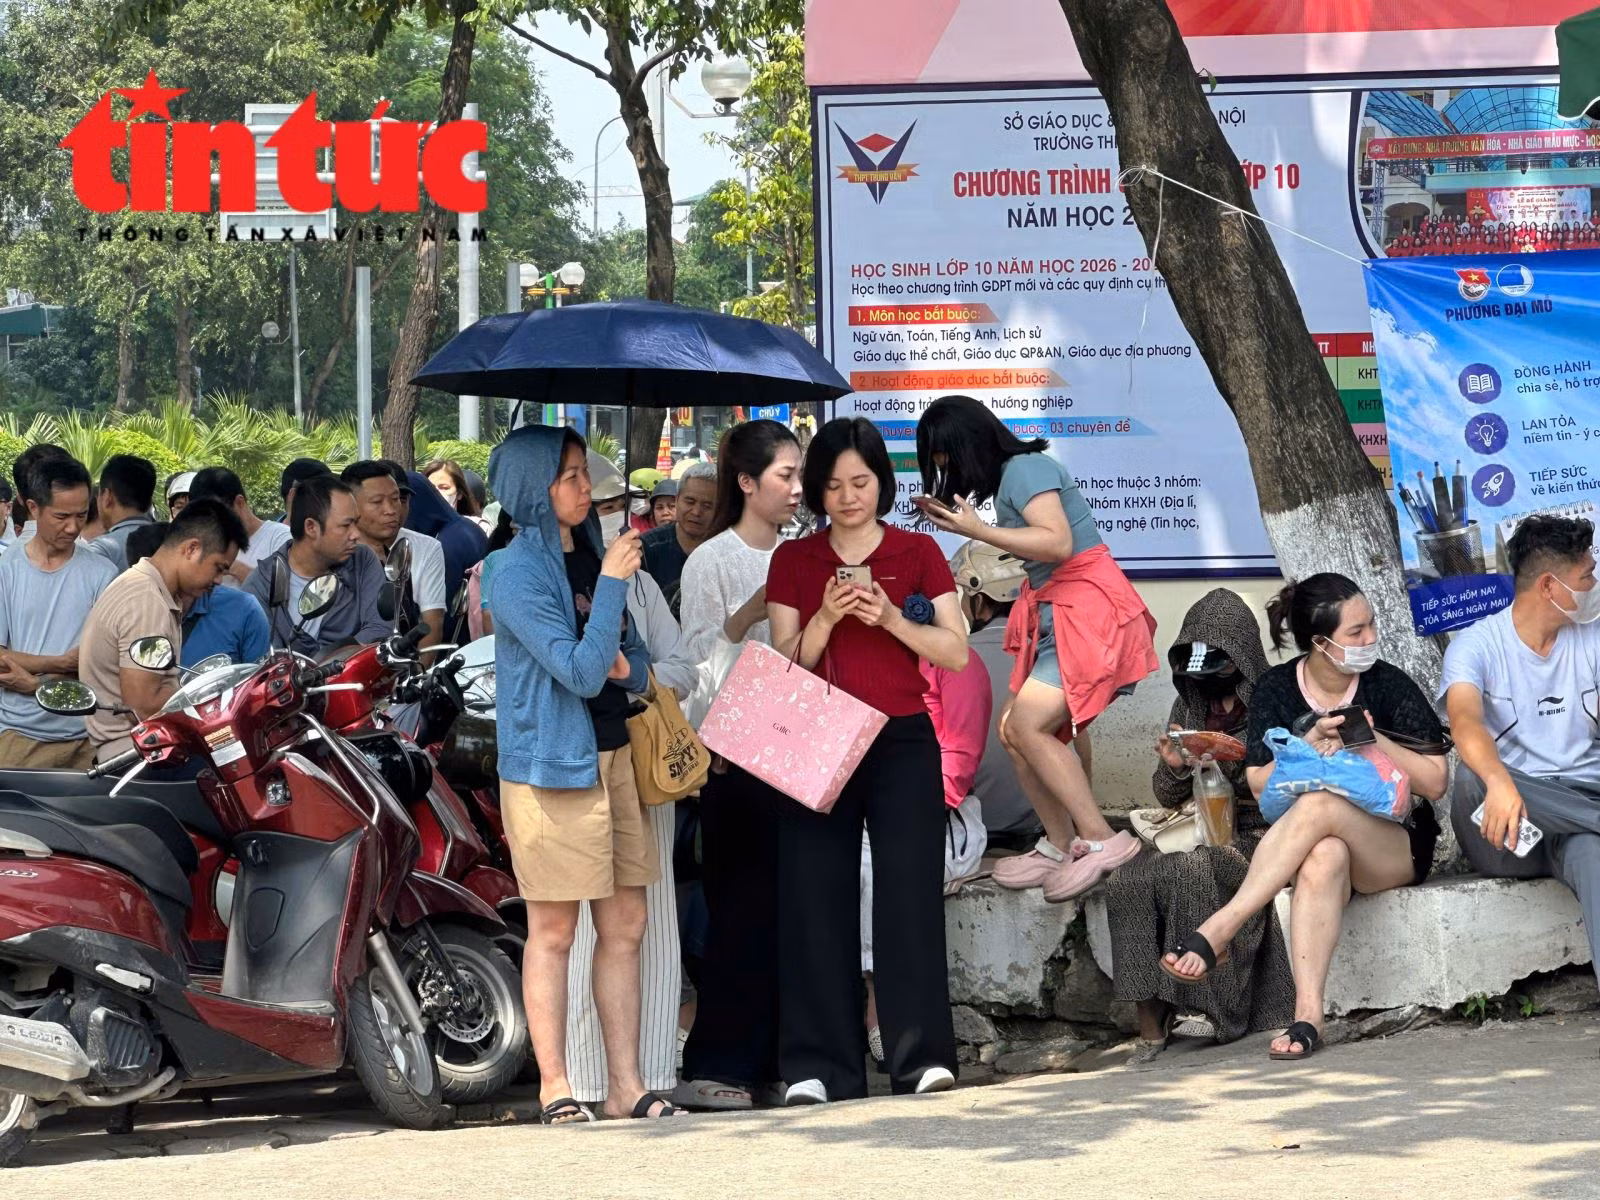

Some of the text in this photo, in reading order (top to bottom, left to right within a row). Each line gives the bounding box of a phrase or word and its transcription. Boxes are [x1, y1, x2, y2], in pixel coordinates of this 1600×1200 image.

[1004, 111, 1024, 130] SỞ
[1028, 112, 1067, 129] GIÁO
[1072, 114, 1103, 131] DỤC
[1218, 106, 1246, 127] NỘI
[1034, 132, 1093, 151] TRƯỜNG
[1486, 136, 1501, 150] HÓA
[1508, 135, 1523, 149] NHÀ
[1525, 134, 1542, 149] GIÁO
[1562, 133, 1580, 150] MỰC
[854, 174, 868, 182] THPT
[953, 168, 1041, 198] CHƯƠNG
[1047, 163, 1110, 195] TRÌNH
[1240, 159, 1266, 190] ỚP
[1275, 163, 1300, 190] 10
[1007, 202, 1057, 228] NĂM
[1066, 205, 1114, 230] HỌC
[851, 264, 886, 280] HỌC
[892, 263, 930, 277] SINH
[936, 259, 968, 276] LỚP
[975, 261, 992, 275] 10
[998, 257, 1034, 274] NĂM
[1039, 259, 1074, 276] HỌC
[1080, 258, 1117, 272] 2026
[851, 276, 1166, 297] Học theo chương trình GDPT mới và các quy định cụ th
[856, 305, 981, 323] 1. Môn học bắt buộc:
[1446, 302, 1501, 322] PHƯỜNG
[1504, 302, 1527, 318] ĐẠI
[853, 325, 1042, 345] Ngữ văn, Toán, Tiếng Anh, Lịch sử
[853, 343, 1191, 364] Giáo dục thể chất, Giáo dục QP&AN, Giáo dục địa phương
[1362, 341, 1376, 354] NH
[1358, 368, 1379, 379] KHT
[1514, 360, 1591, 379] ĐỒNG HÀNH
[873, 375, 899, 388] Hoạt
[903, 373, 933, 388] động
[937, 373, 964, 389] giáo
[967, 373, 989, 387] dục
[993, 369, 1012, 385] bắt
[1016, 371, 1050, 385] buộc:
[1517, 375, 1600, 394] chia sẻ, hỗ trợ
[854, 400, 881, 414] Hoạt
[884, 399, 915, 414] động
[991, 396, 1029, 410] hướng
[1032, 396, 1073, 411] nghiệp
[1050, 423, 1063, 434] 03
[1067, 422, 1111, 436] chuyên
[1115, 418, 1131, 432] đề
[1522, 414, 1576, 431] LAN TỎA
[1557, 430, 1572, 441] tin
[1583, 427, 1590, 441] ý
[1091, 477, 1113, 491] học
[1118, 476, 1150, 491] thuộc
[1154, 477, 1161, 488] 3
[1164, 474, 1201, 488] nhóm:
[1529, 465, 1587, 483] TIẾP SỨC
[1531, 483, 1545, 496] về
[1549, 480, 1574, 494] kiến
[1124, 496, 1156, 508] KHXH
[1160, 496, 1184, 510] (Địa
[1187, 494, 1197, 509] lí,
[1116, 516, 1146, 531] nghệ
[1151, 516, 1168, 530] (Tin
[1173, 516, 1199, 531] học,
[1421, 585, 1496, 611] TIẾP SỨC HÔM NAY
[1423, 613, 1440, 626] TỎA
[1441, 608, 1464, 621] SÁNG
[1466, 601, 1487, 614] NGÀY
